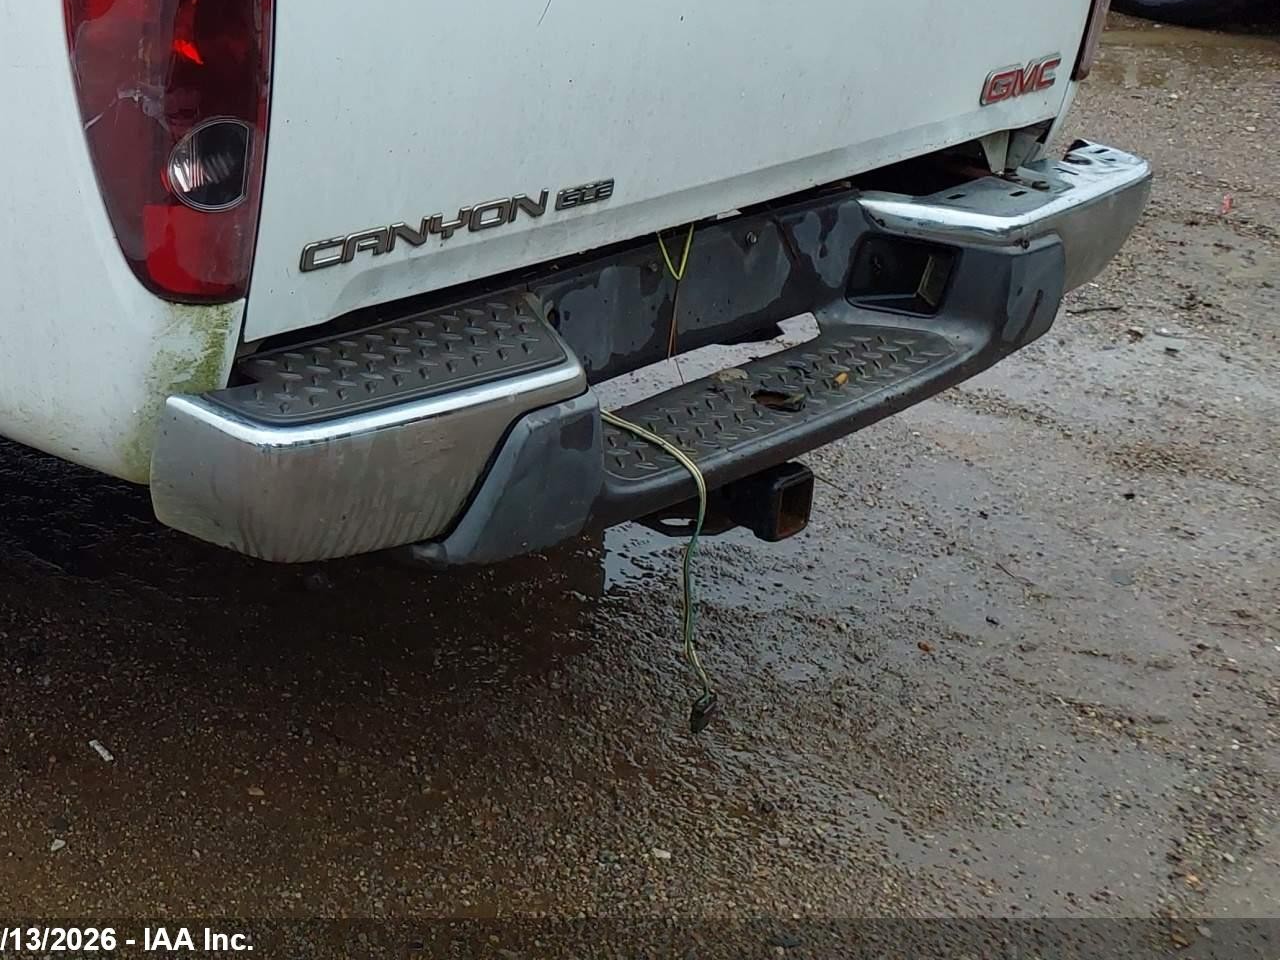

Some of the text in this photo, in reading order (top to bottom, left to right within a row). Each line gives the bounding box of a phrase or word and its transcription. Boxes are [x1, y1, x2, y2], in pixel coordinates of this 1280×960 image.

[979, 52, 1062, 107] GMC
[299, 177, 615, 273] CANYON SLE
